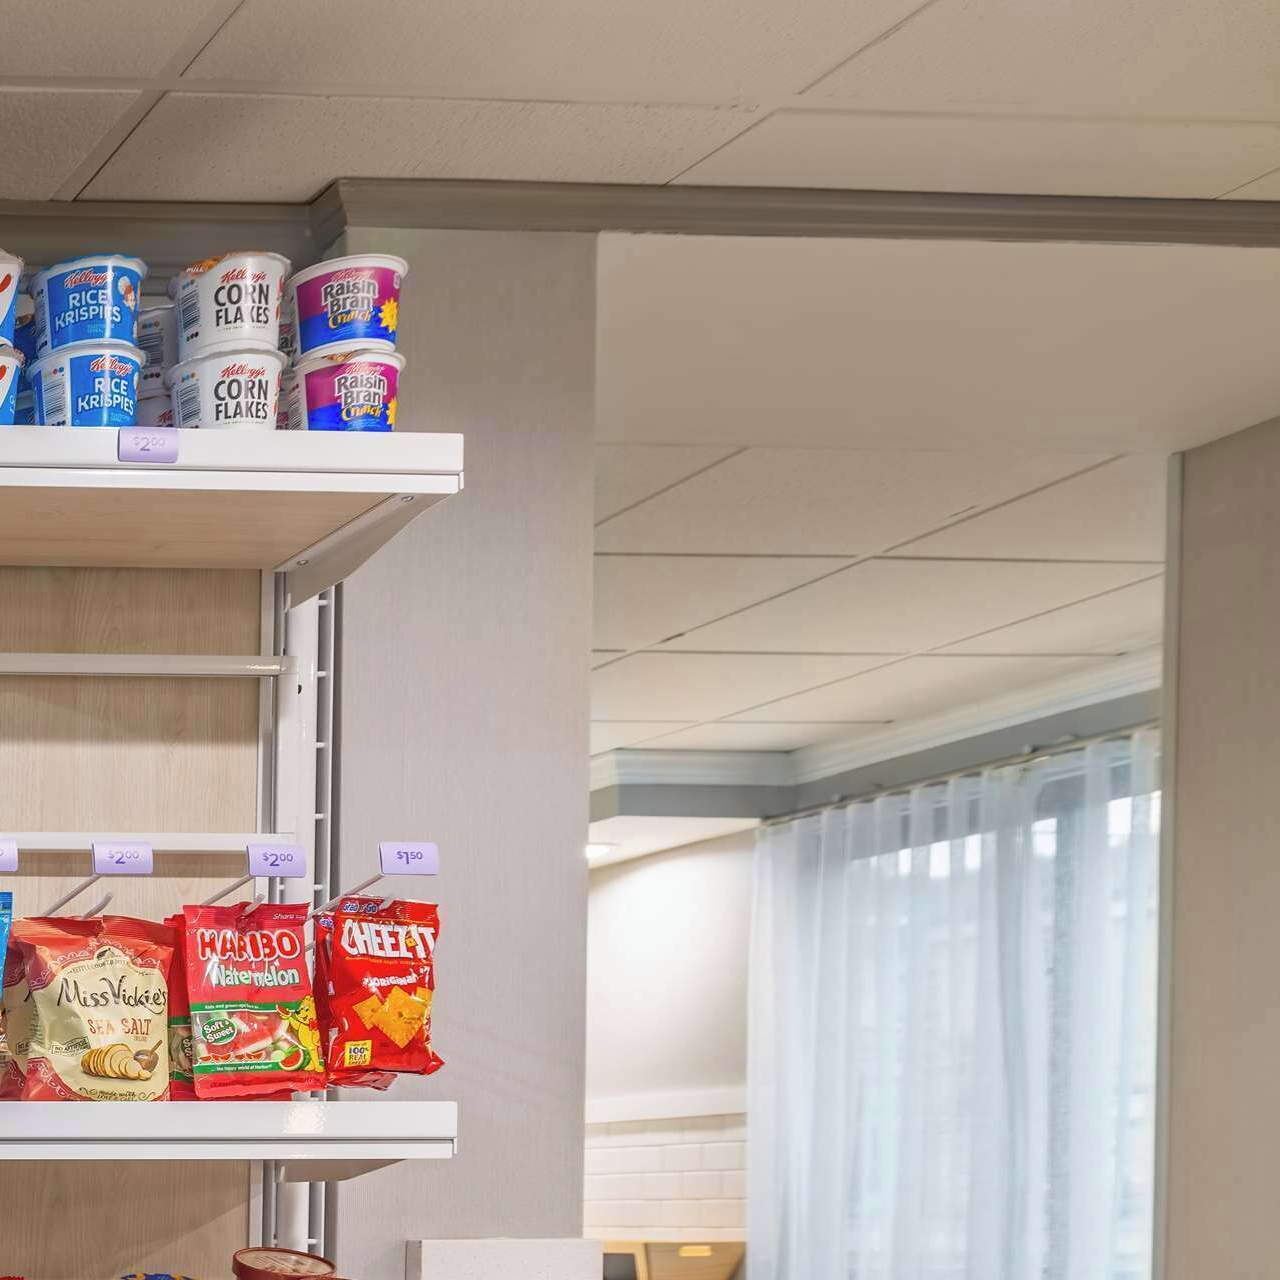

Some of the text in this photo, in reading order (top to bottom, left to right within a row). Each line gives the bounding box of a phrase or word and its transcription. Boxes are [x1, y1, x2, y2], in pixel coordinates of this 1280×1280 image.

[68, 289, 108, 307] RICE
[214, 283, 270, 308] CORN
[322, 278, 378, 300] Raisin
[328, 295, 374, 315] Bran
[55, 306, 121, 332] KRISPIES
[94, 377, 128, 395] RICE
[197, 929, 300, 961] HARIBO
[88, 1019, 152, 1036] SEA SALT
